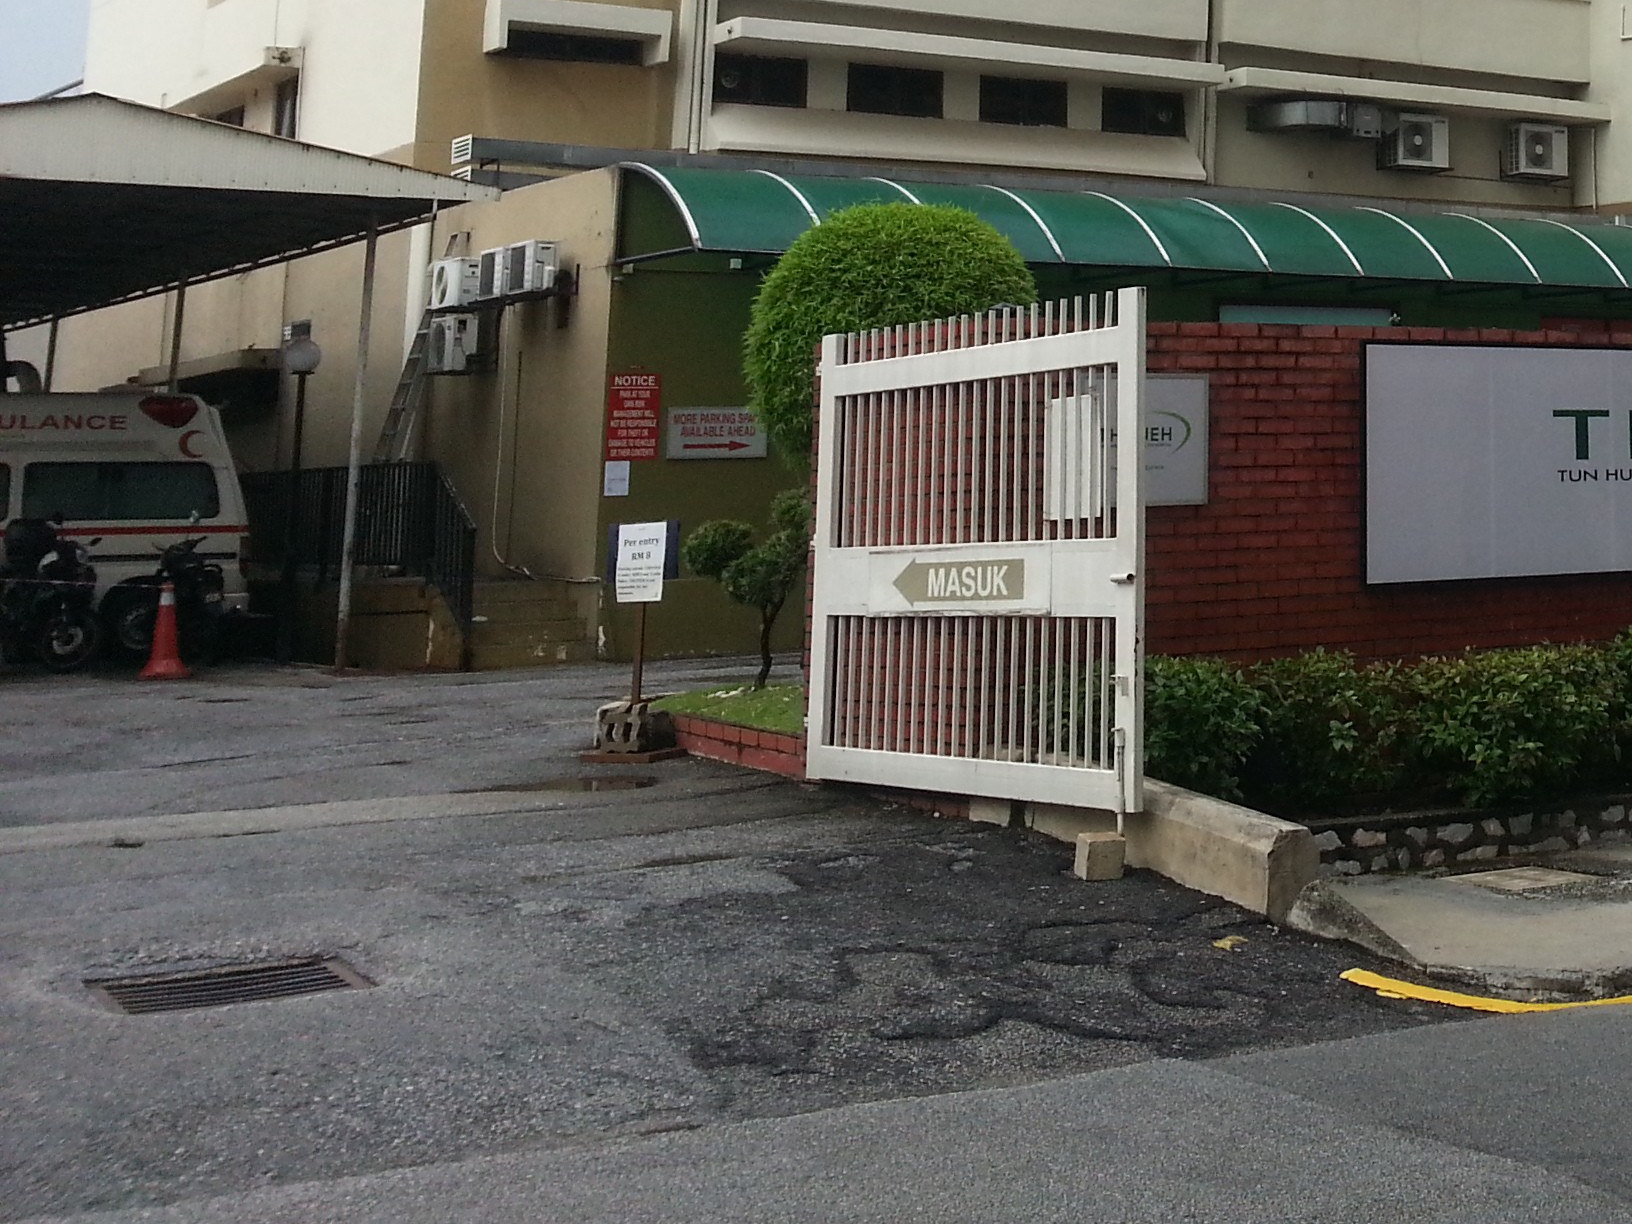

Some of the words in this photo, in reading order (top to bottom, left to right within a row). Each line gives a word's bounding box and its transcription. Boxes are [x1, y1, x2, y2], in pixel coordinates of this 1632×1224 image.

[614, 375, 656, 386] NOTICE
[673, 413, 698, 424] MORE
[700, 413, 736, 424] PARKING
[738, 413, 756, 424] SPA
[680, 425, 724, 437] AVAILABLE
[727, 425, 756, 437] AHEAD
[1557, 468, 1598, 482] TUN
[623, 539, 637, 547] Per
[638, 537, 660, 547] entry
[631, 552, 644, 561] RM
[927, 565, 1009, 597] MASUK
